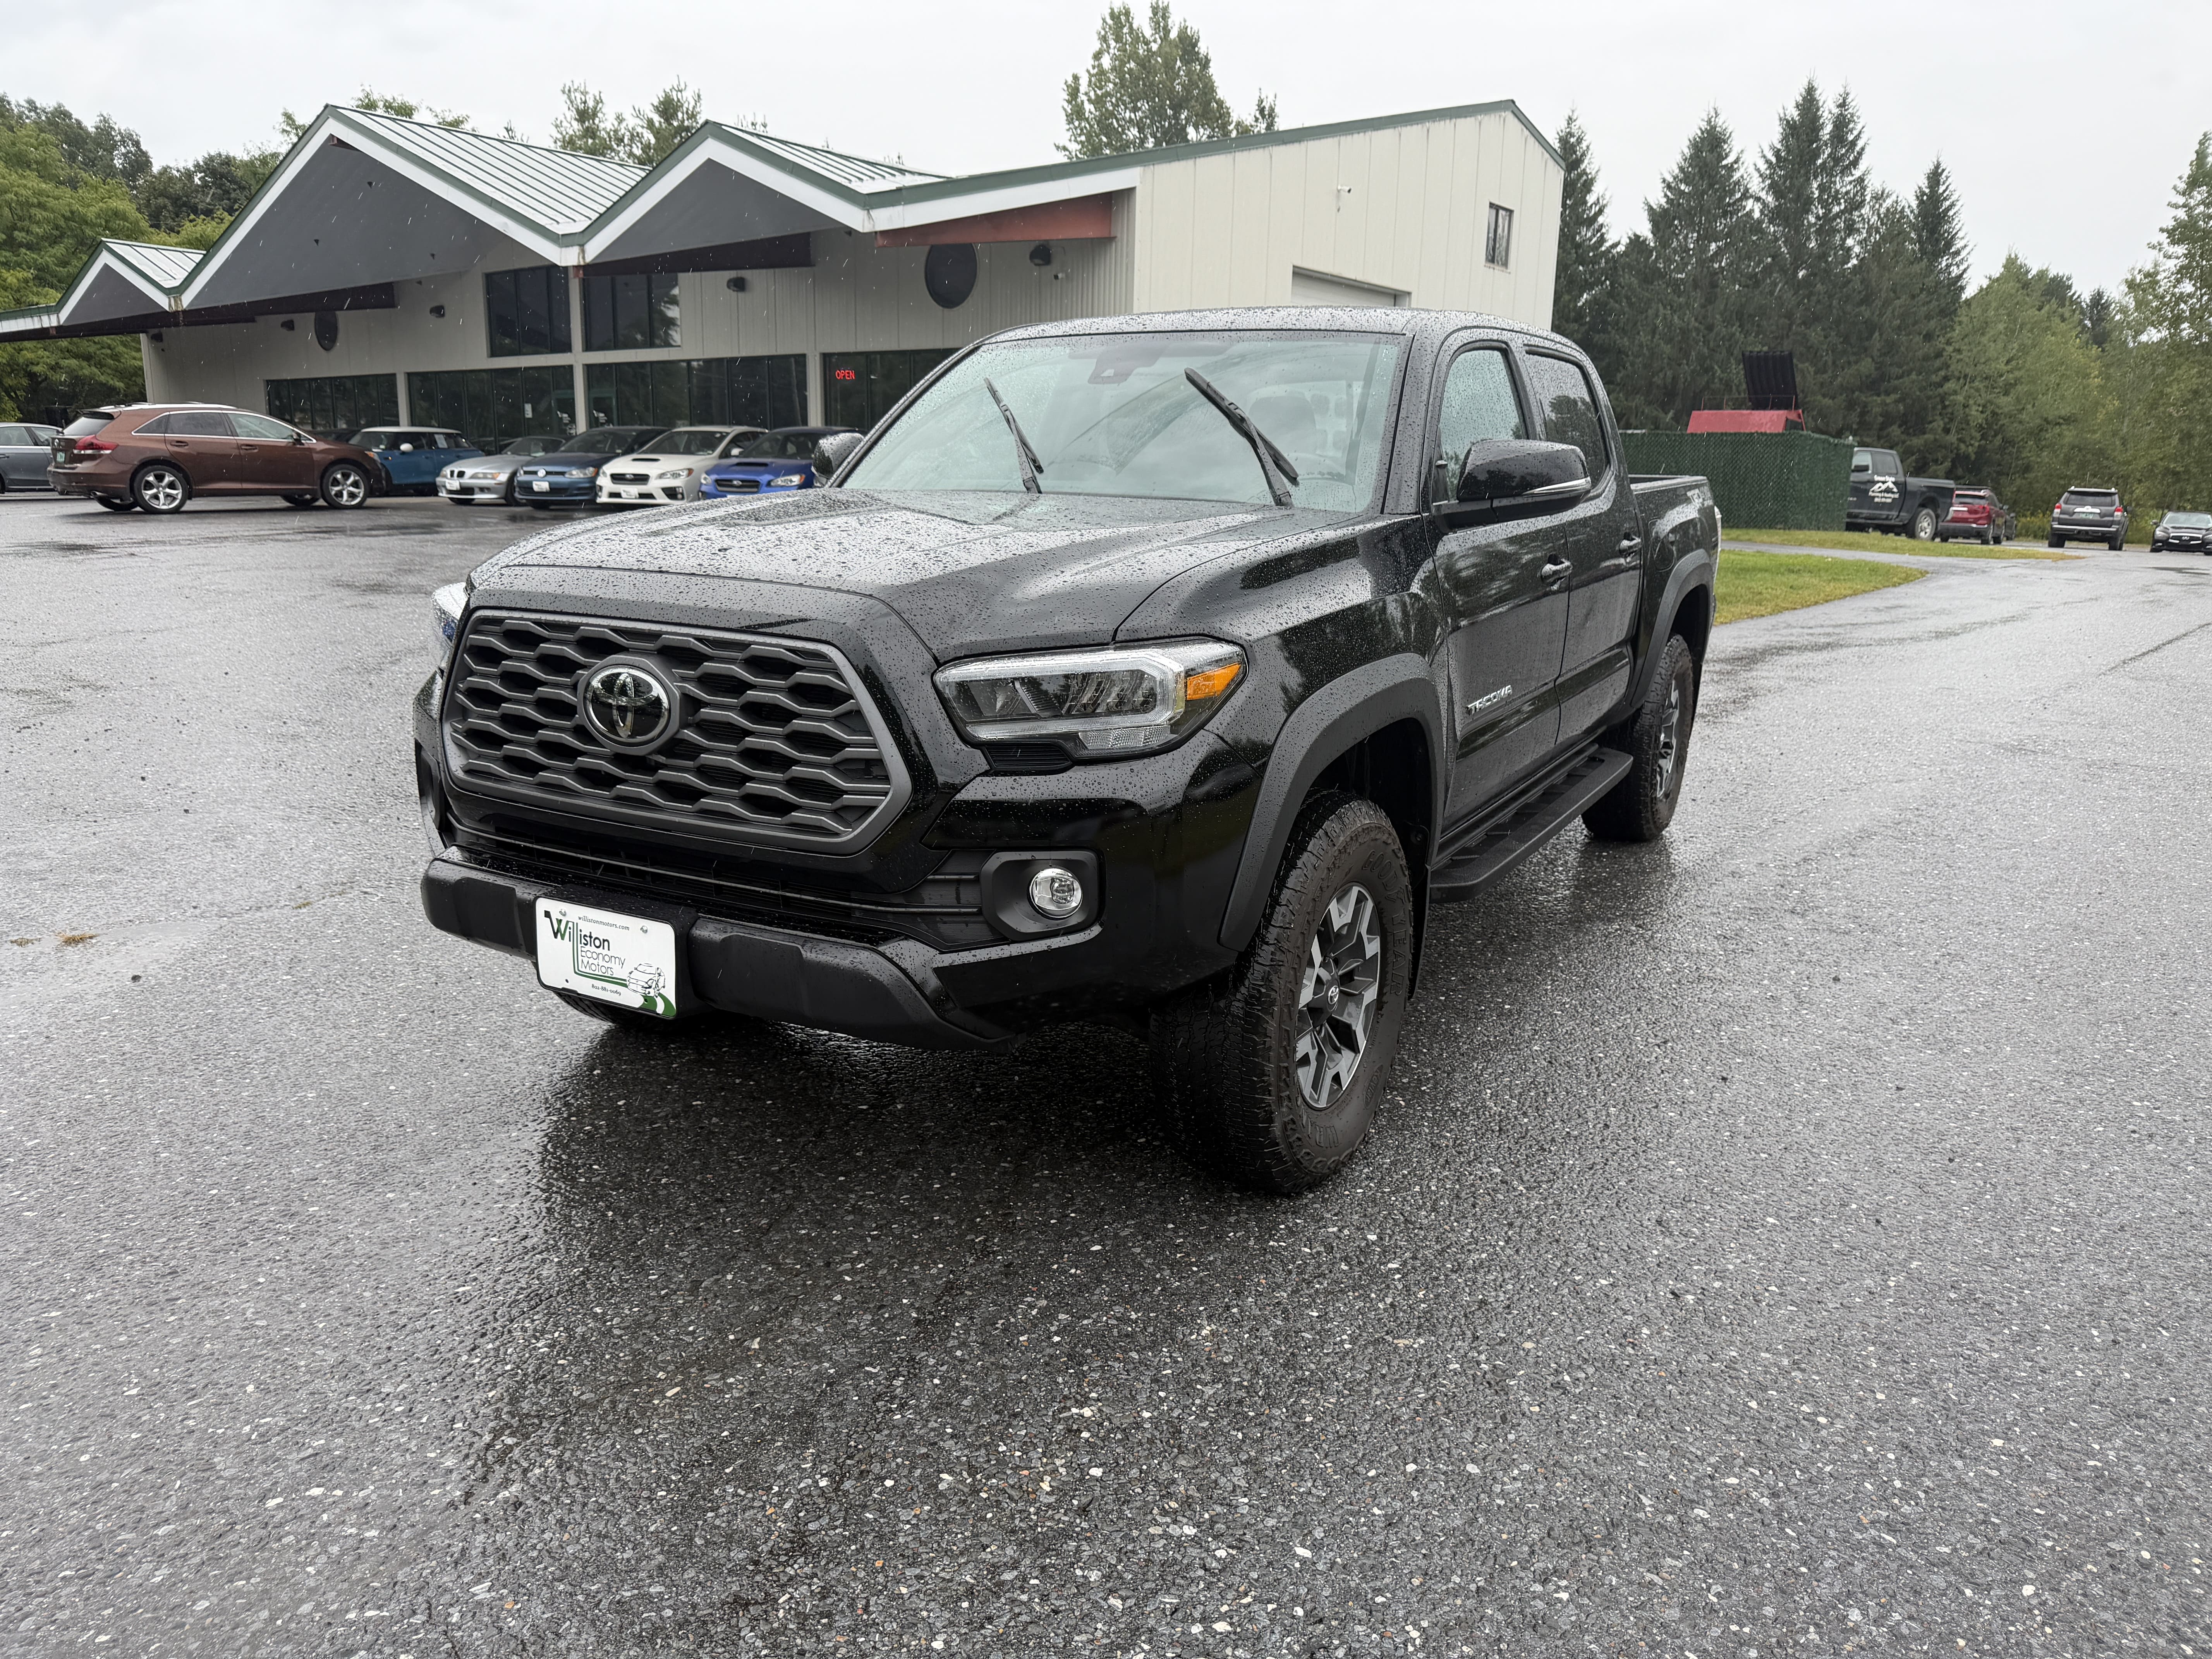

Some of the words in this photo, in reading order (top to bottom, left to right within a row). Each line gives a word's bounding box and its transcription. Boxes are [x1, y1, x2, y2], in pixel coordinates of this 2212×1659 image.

[836, 370, 855, 380] OPEN
[1467, 685, 1512, 715] TACOMA
[544, 910, 610, 951] Williston
[578, 915, 630, 931] willistonmotors.com
[1361, 849, 1407, 996] GOODYEAR
[580, 946, 626, 969] Economy
[581, 958, 614, 976] Motors
[1365, 1069, 1382, 1102] Kevlar
